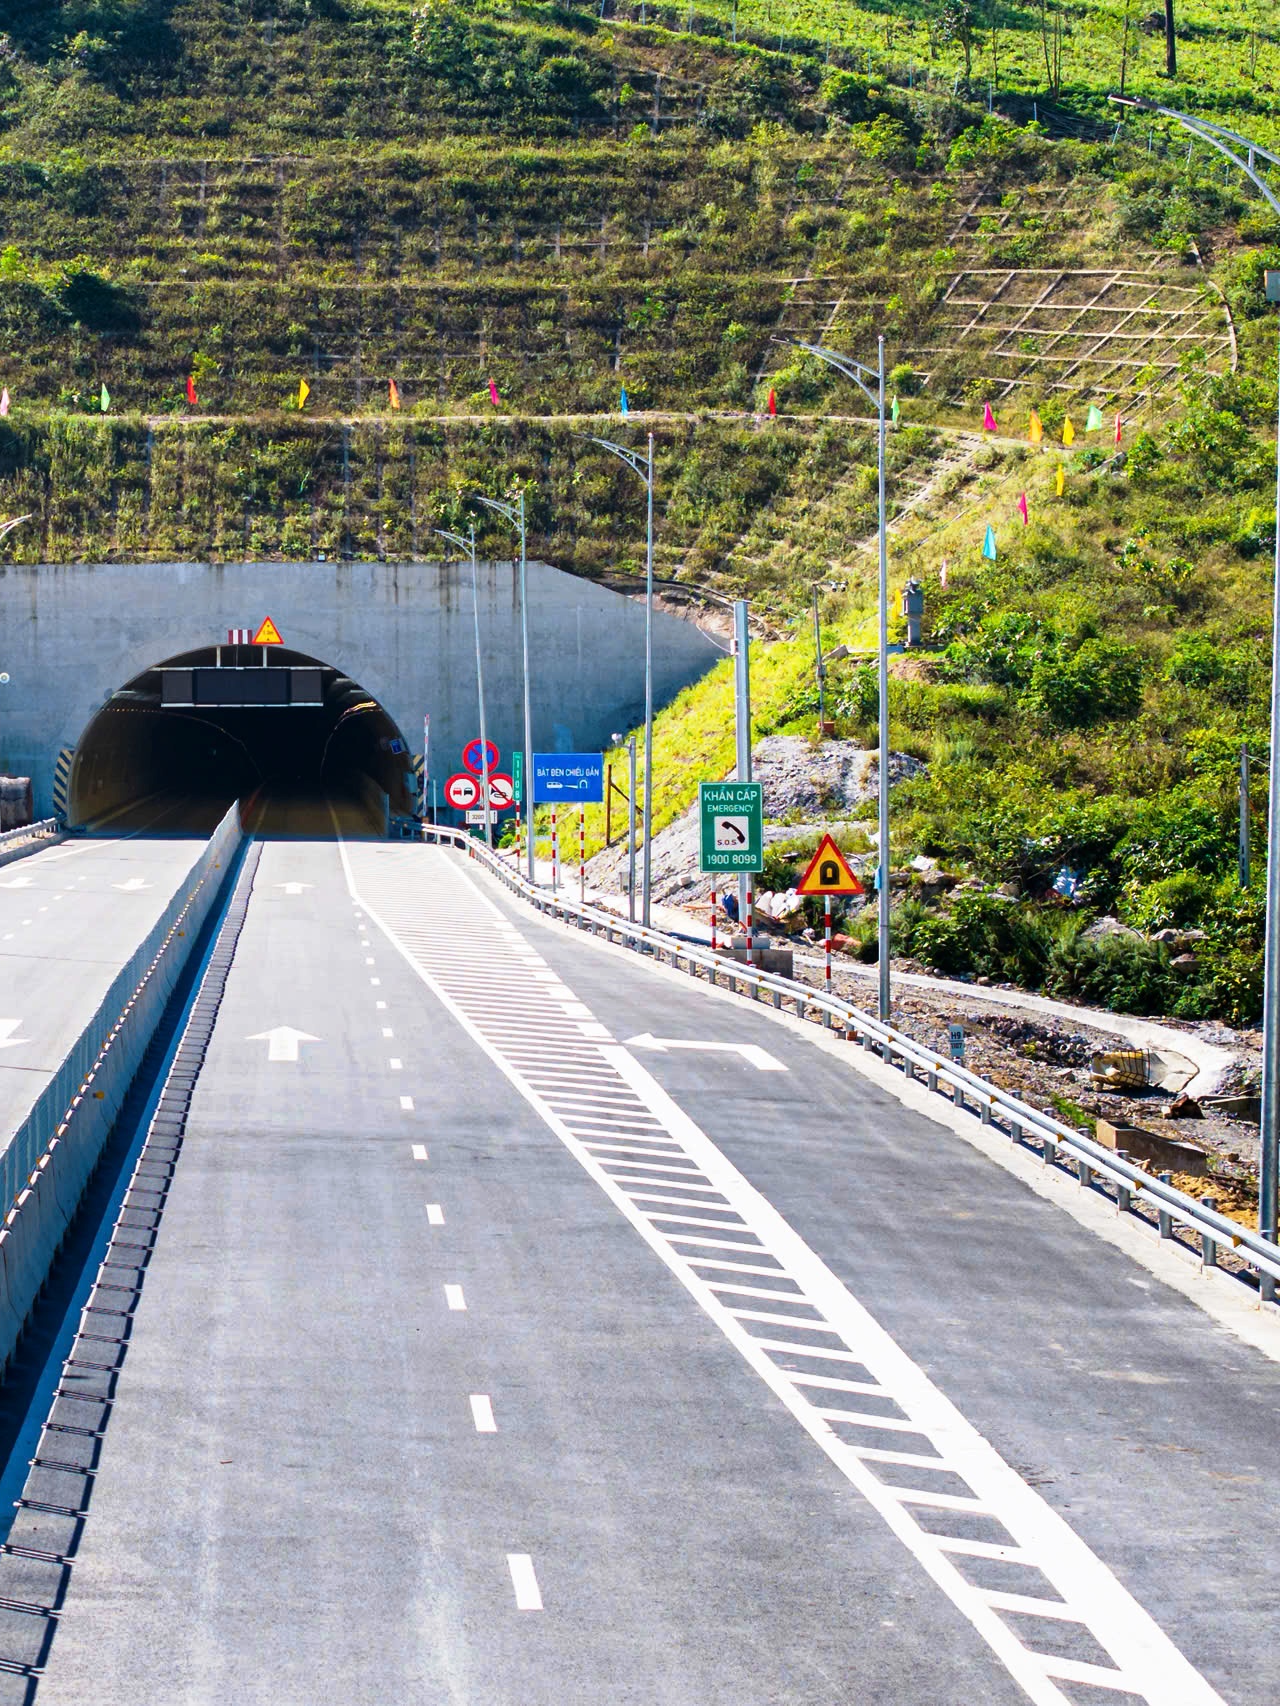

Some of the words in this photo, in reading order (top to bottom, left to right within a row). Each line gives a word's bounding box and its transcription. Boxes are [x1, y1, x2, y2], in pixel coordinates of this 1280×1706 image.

[736, 786, 758, 801] CẤP
[707, 804, 754, 813] EMERGENCY
[707, 854, 730, 865] 1900
[732, 854, 757, 865] 8099
[950, 1031, 962, 1040] H9
